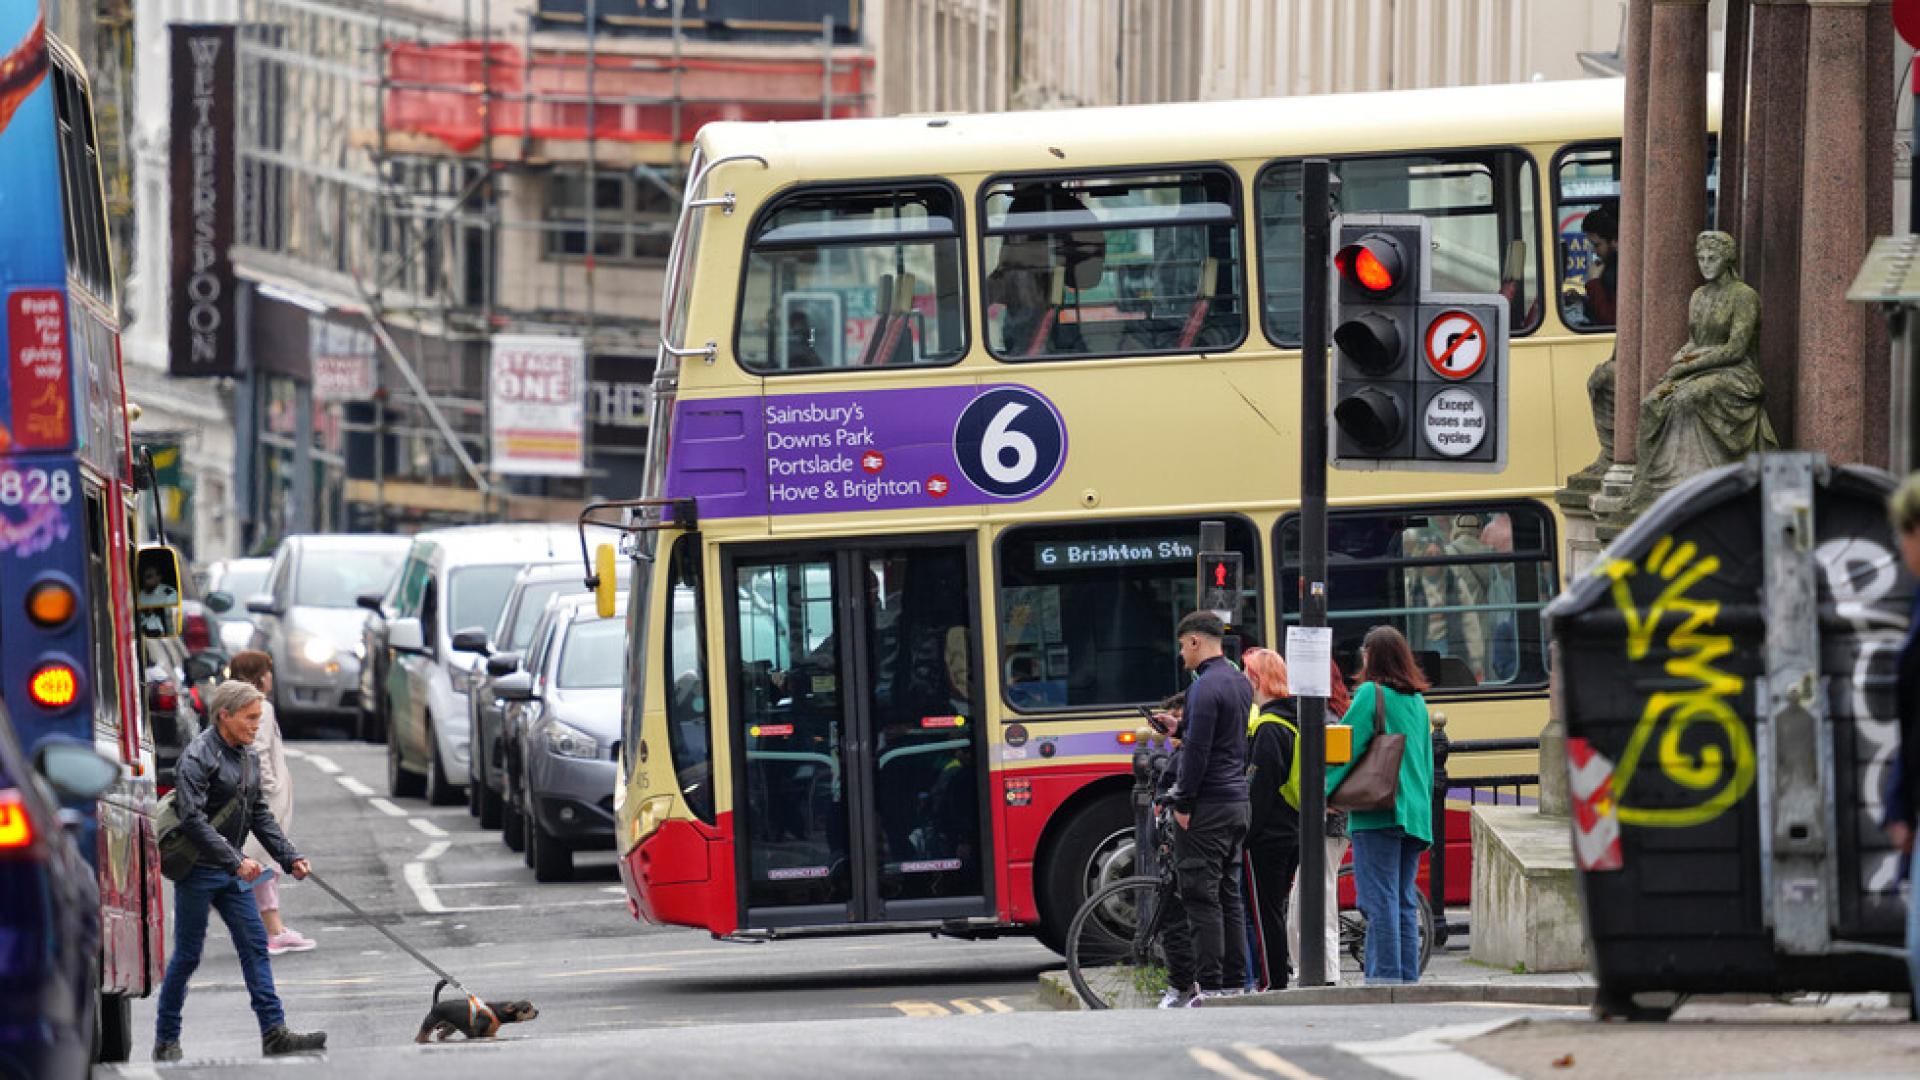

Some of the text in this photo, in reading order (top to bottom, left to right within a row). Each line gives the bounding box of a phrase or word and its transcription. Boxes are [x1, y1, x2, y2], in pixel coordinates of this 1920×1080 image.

[188, 37, 221, 363] WETHERSPOON
[20, 347, 62, 367] giving
[498, 375, 570, 399] ONE
[766, 402, 864, 426] Sainsbury's
[1438, 398, 1473, 413] Except
[1428, 414, 1482, 428] buses and
[767, 427, 875, 450] Downs Park
[980, 401, 1037, 484] 6
[1438, 431, 1471, 445] cycles
[768, 453, 853, 476] Portslade
[0, 469, 72, 505] 828
[769, 478, 922, 502] Hove & Brighton
[1041, 541, 1193, 564] 6 Brighton Stn
